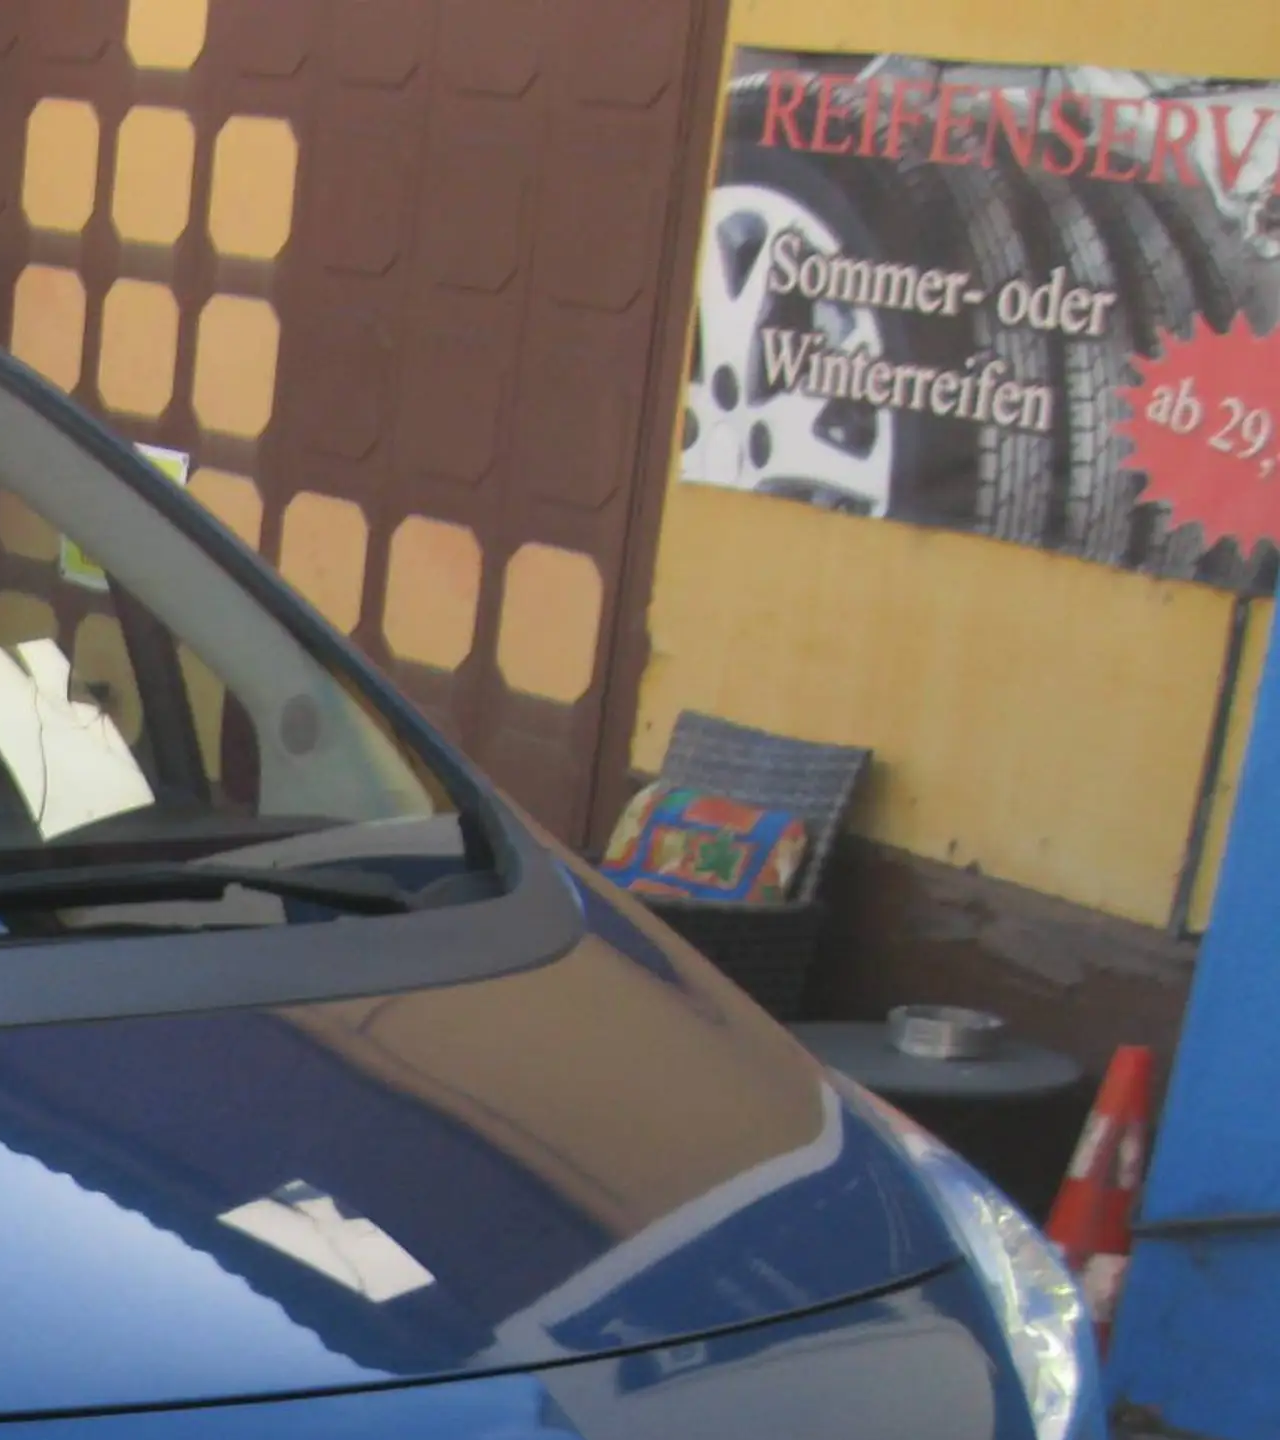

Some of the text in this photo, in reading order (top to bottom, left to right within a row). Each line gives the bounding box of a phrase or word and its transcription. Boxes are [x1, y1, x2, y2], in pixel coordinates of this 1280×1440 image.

[768, 234, 1117, 337] Sommer- oder
[760, 326, 1053, 432] Winterreifen
[1145, 376, 1202, 435] ab
